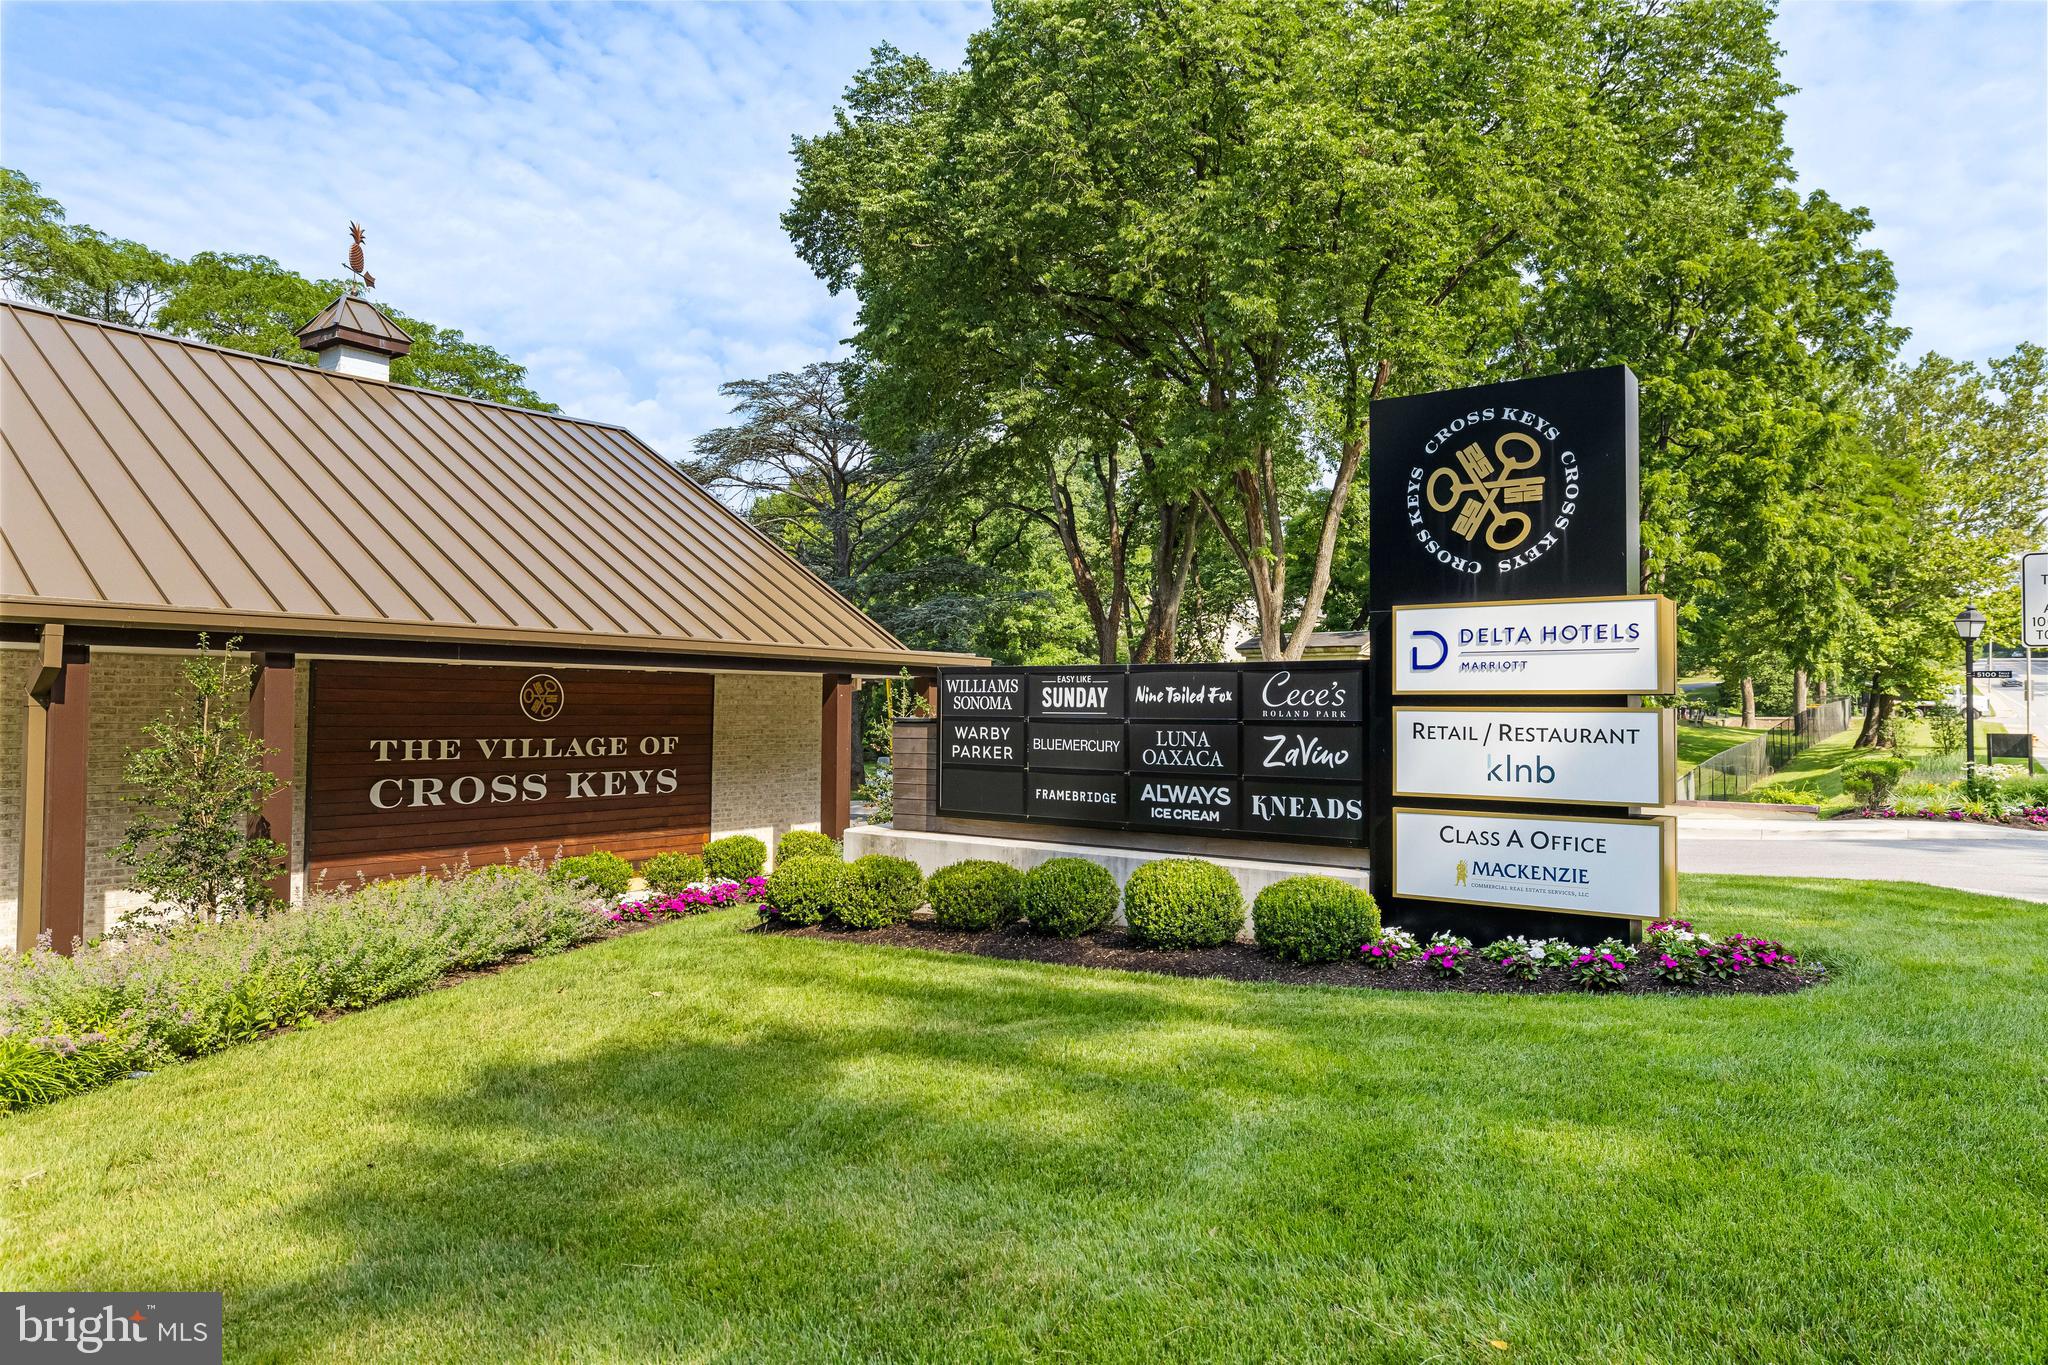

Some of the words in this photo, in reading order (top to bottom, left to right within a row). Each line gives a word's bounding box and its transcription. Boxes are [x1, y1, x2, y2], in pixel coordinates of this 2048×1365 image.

[1425, 408, 1495, 454] CROSS
[1501, 407, 1560, 441] KEYS
[1407, 467, 1424, 526] KEYS
[1555, 450, 1579, 530] CROSS
[1417, 529, 1482, 574] CROSS
[1498, 531, 1559, 573] KEYS
[1461, 628, 1531, 642] DELTA
[1544, 623, 1640, 640] HOTELS
[1461, 661, 1528, 670] MARRIOTT
[946, 679, 1018, 693] WILLIAMS
[1136, 686, 1163, 703] Nine
[1166, 685, 1205, 703] Tailed
[1208, 687, 1232, 703] Fox
[1262, 671, 1345, 707] Cece's
[954, 696, 1012, 709] SONOMA
[1042, 687, 1108, 707] SUNDAY
[955, 727, 1010, 740] WARBY
[1156, 731, 1210, 747] LUNA
[370, 740, 460, 761] THE
[476, 737, 627, 759] VILLAGE
[640, 737, 678, 755] OF
[953, 745, 1012, 759] PARKER
[1034, 738, 1120, 752] BLUEMERCURY
[1143, 749, 1223, 767] OAXACA
[1487, 754, 1556, 783] klnb
[370, 774, 547, 808] CROSS
[566, 769, 677, 798] KEYS
[1036, 789, 1116, 803] FRAMEBRIDGE
[1141, 784, 1231, 806] ALWAYS
[1151, 809, 1171, 820] ICE
[1173, 809, 1219, 822] CREAM
[1252, 795, 1362, 821] KNEADS
[1507, 830, 1523, 848] A
[1472, 861, 1590, 884] MACKENZIE
[1471, 883, 1508, 891] COMMERCIAL
